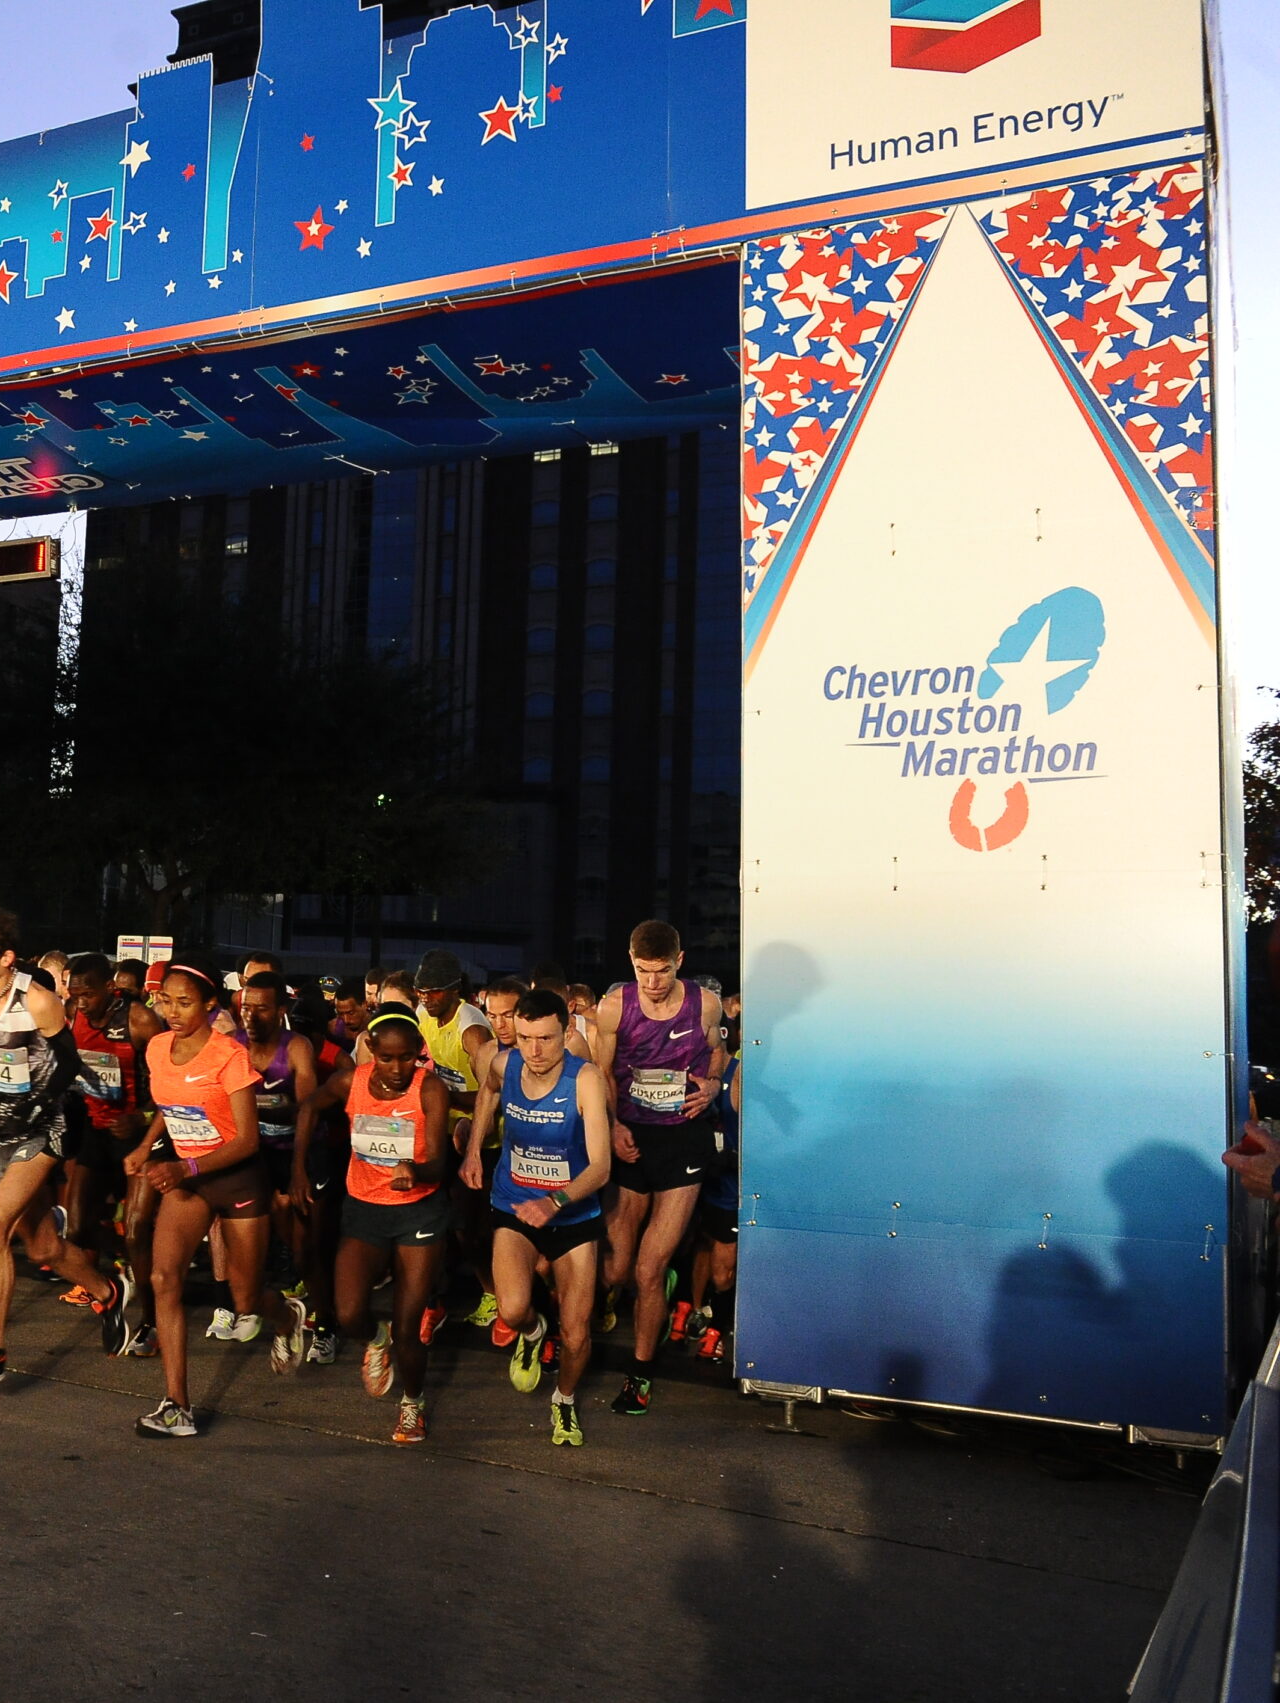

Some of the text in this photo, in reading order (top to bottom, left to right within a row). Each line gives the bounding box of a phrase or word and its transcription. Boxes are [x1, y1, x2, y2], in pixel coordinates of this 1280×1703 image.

[829, 126, 958, 170] Human
[972, 96, 1109, 144] Energy
[823, 664, 975, 701] Chevron
[858, 697, 1022, 739] Houston
[901, 735, 1097, 778] Marathon
[630, 1087, 684, 1100] PUSKEDRA
[506, 1102, 565, 1118] ASCLEPIOS
[369, 1142, 398, 1154] AGA
[525, 1151, 562, 1160] Chevron
[517, 1162, 560, 1176] ARTUR
